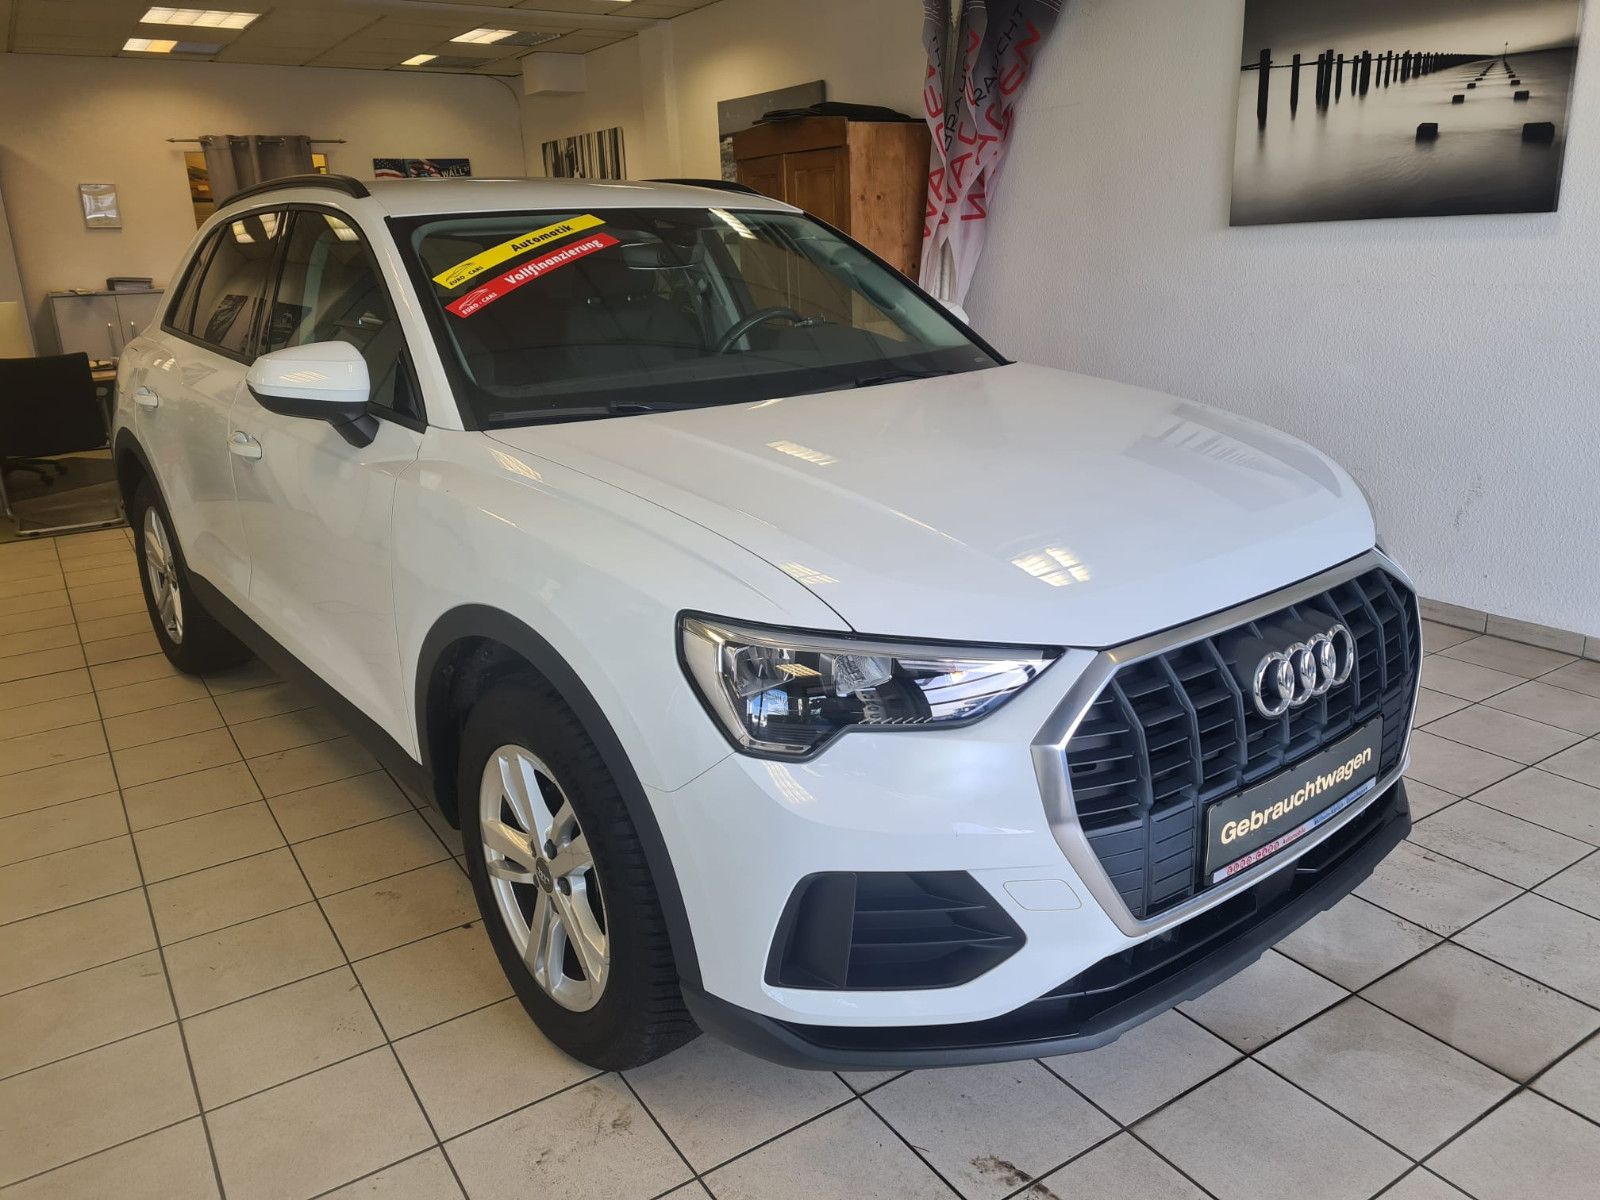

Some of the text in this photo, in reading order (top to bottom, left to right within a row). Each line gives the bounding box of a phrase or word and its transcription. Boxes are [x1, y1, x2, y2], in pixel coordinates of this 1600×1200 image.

[511, 223, 573, 252] Automatik
[449, 265, 485, 286] EURO CARS
[504, 239, 604, 285] Vollfinanzierung
[461, 291, 498, 315] EURO CARS
[1220, 746, 1372, 846] Gebrauchtwagen
